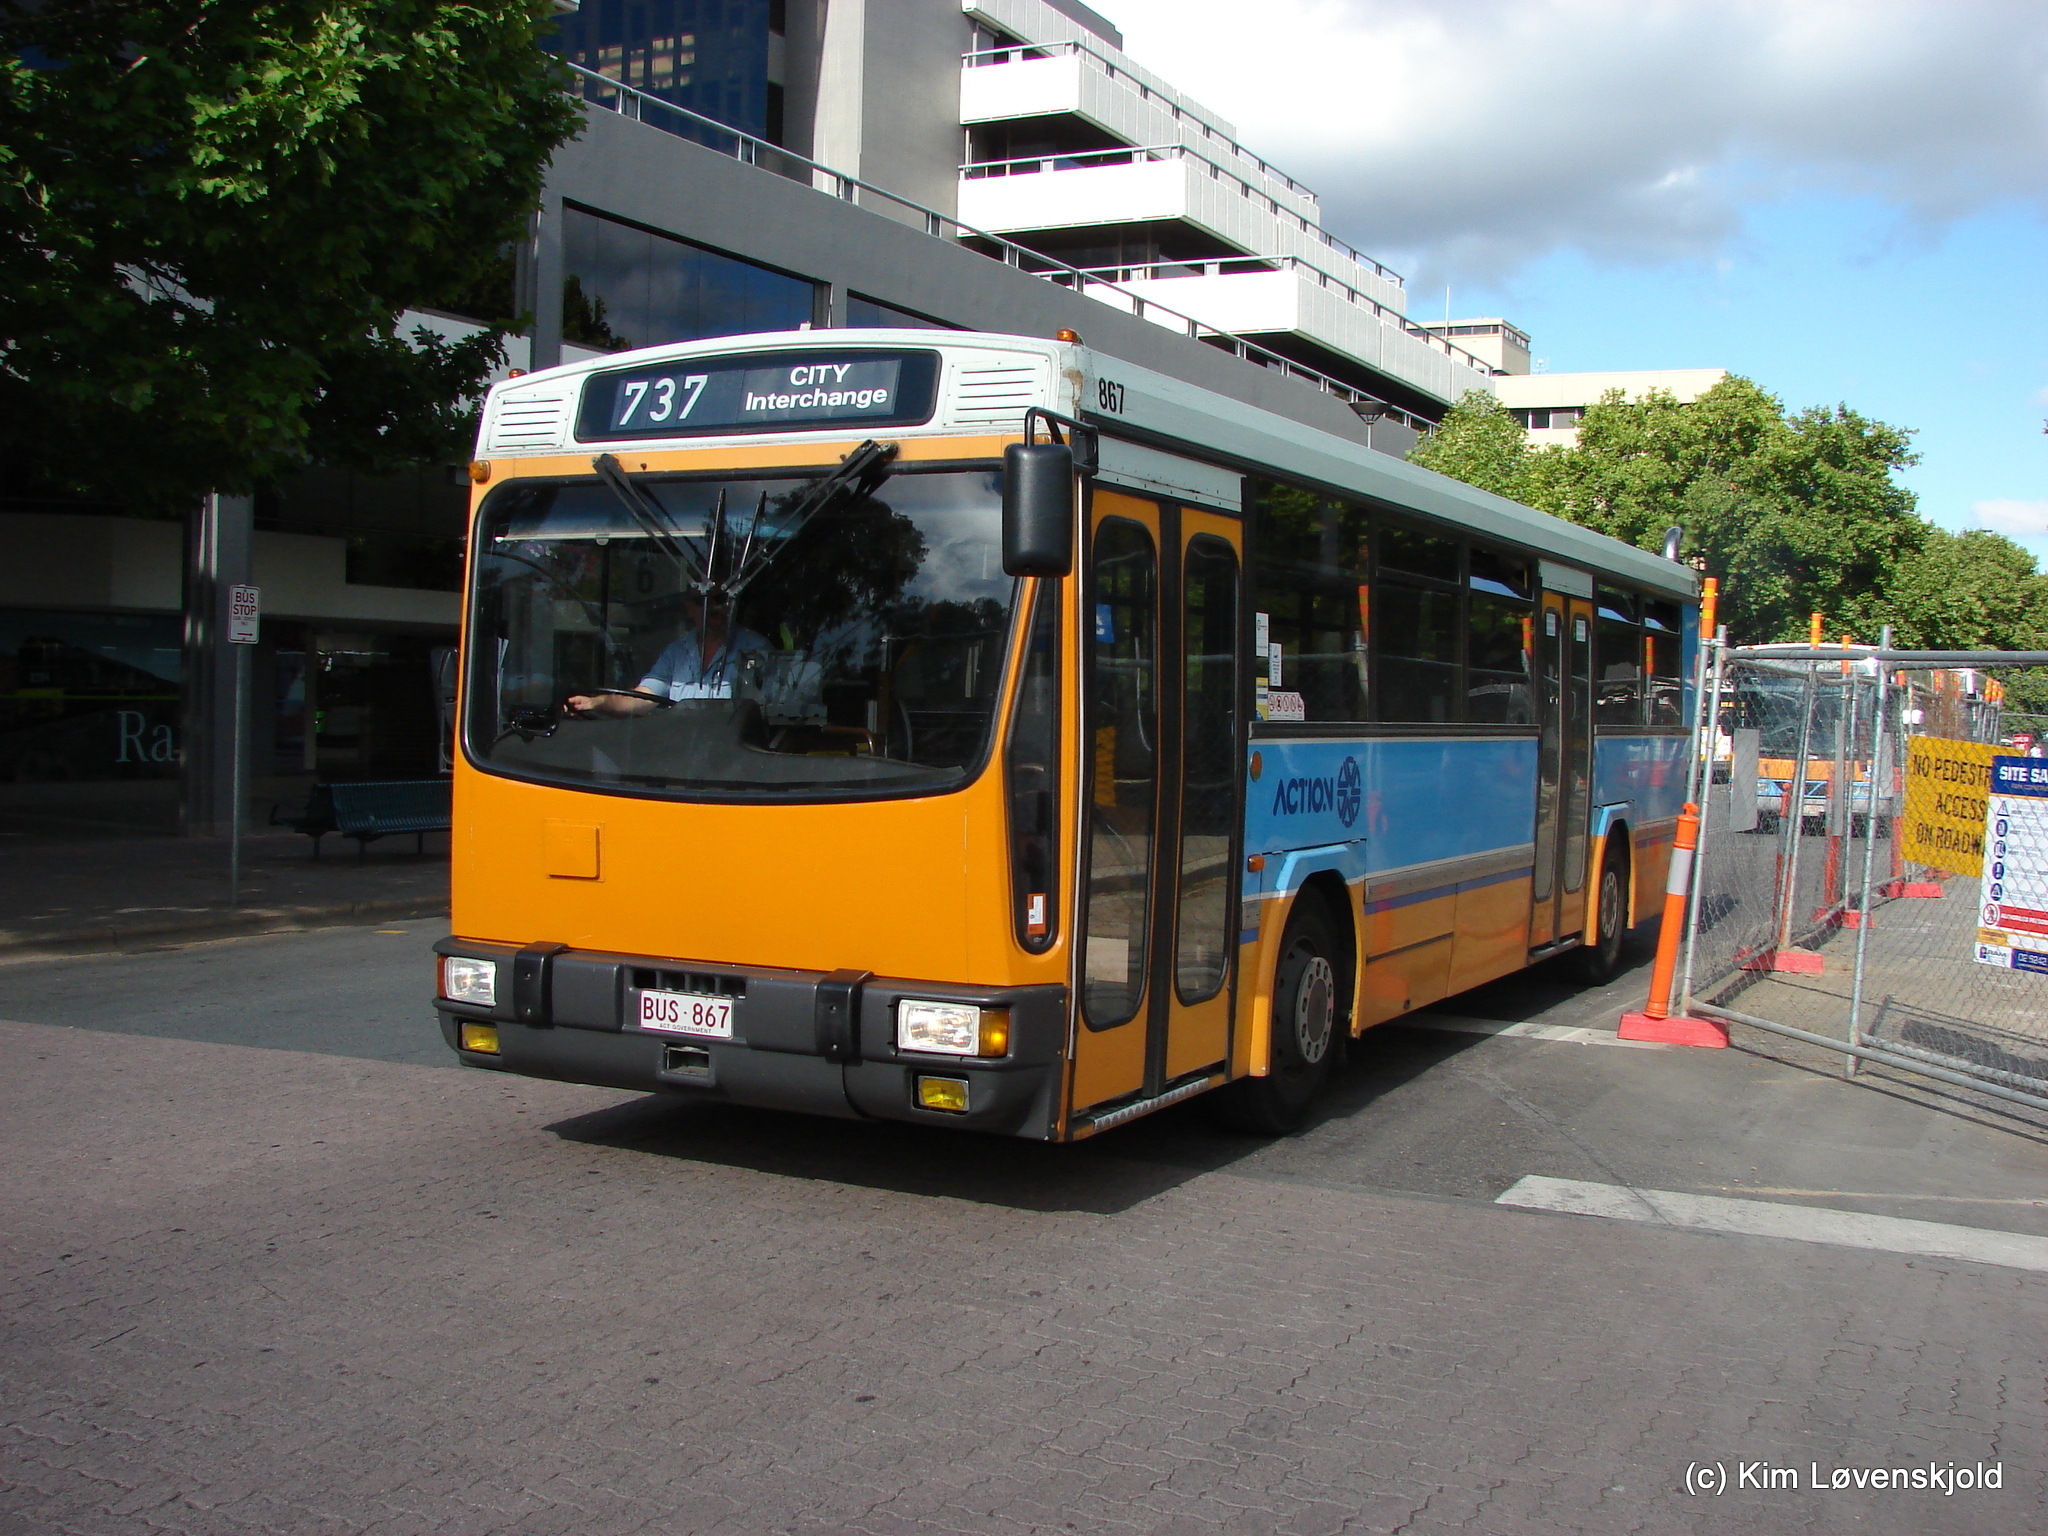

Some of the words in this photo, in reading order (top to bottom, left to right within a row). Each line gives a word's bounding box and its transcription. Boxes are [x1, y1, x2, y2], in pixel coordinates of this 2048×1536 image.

[790, 363, 851, 386] CITY
[619, 374, 708, 426] 737
[745, 388, 888, 411] Interchange
[1098, 377, 1124, 415] 867
[235, 591, 255, 604] BUS
[233, 604, 257, 616] STOP
[1913, 754, 1930, 778] NO
[1998, 765, 2028, 782] SITE
[1272, 777, 1334, 816] ACTION
[1935, 793, 1987, 822] ACCESS
[1916, 822, 1932, 845] ON
[1935, 826, 1985, 858] ROADW
[643, 997, 679, 1023] BUS
[692, 1003, 730, 1028] 867
[672, 1024, 712, 1034] GOVERNMENT
